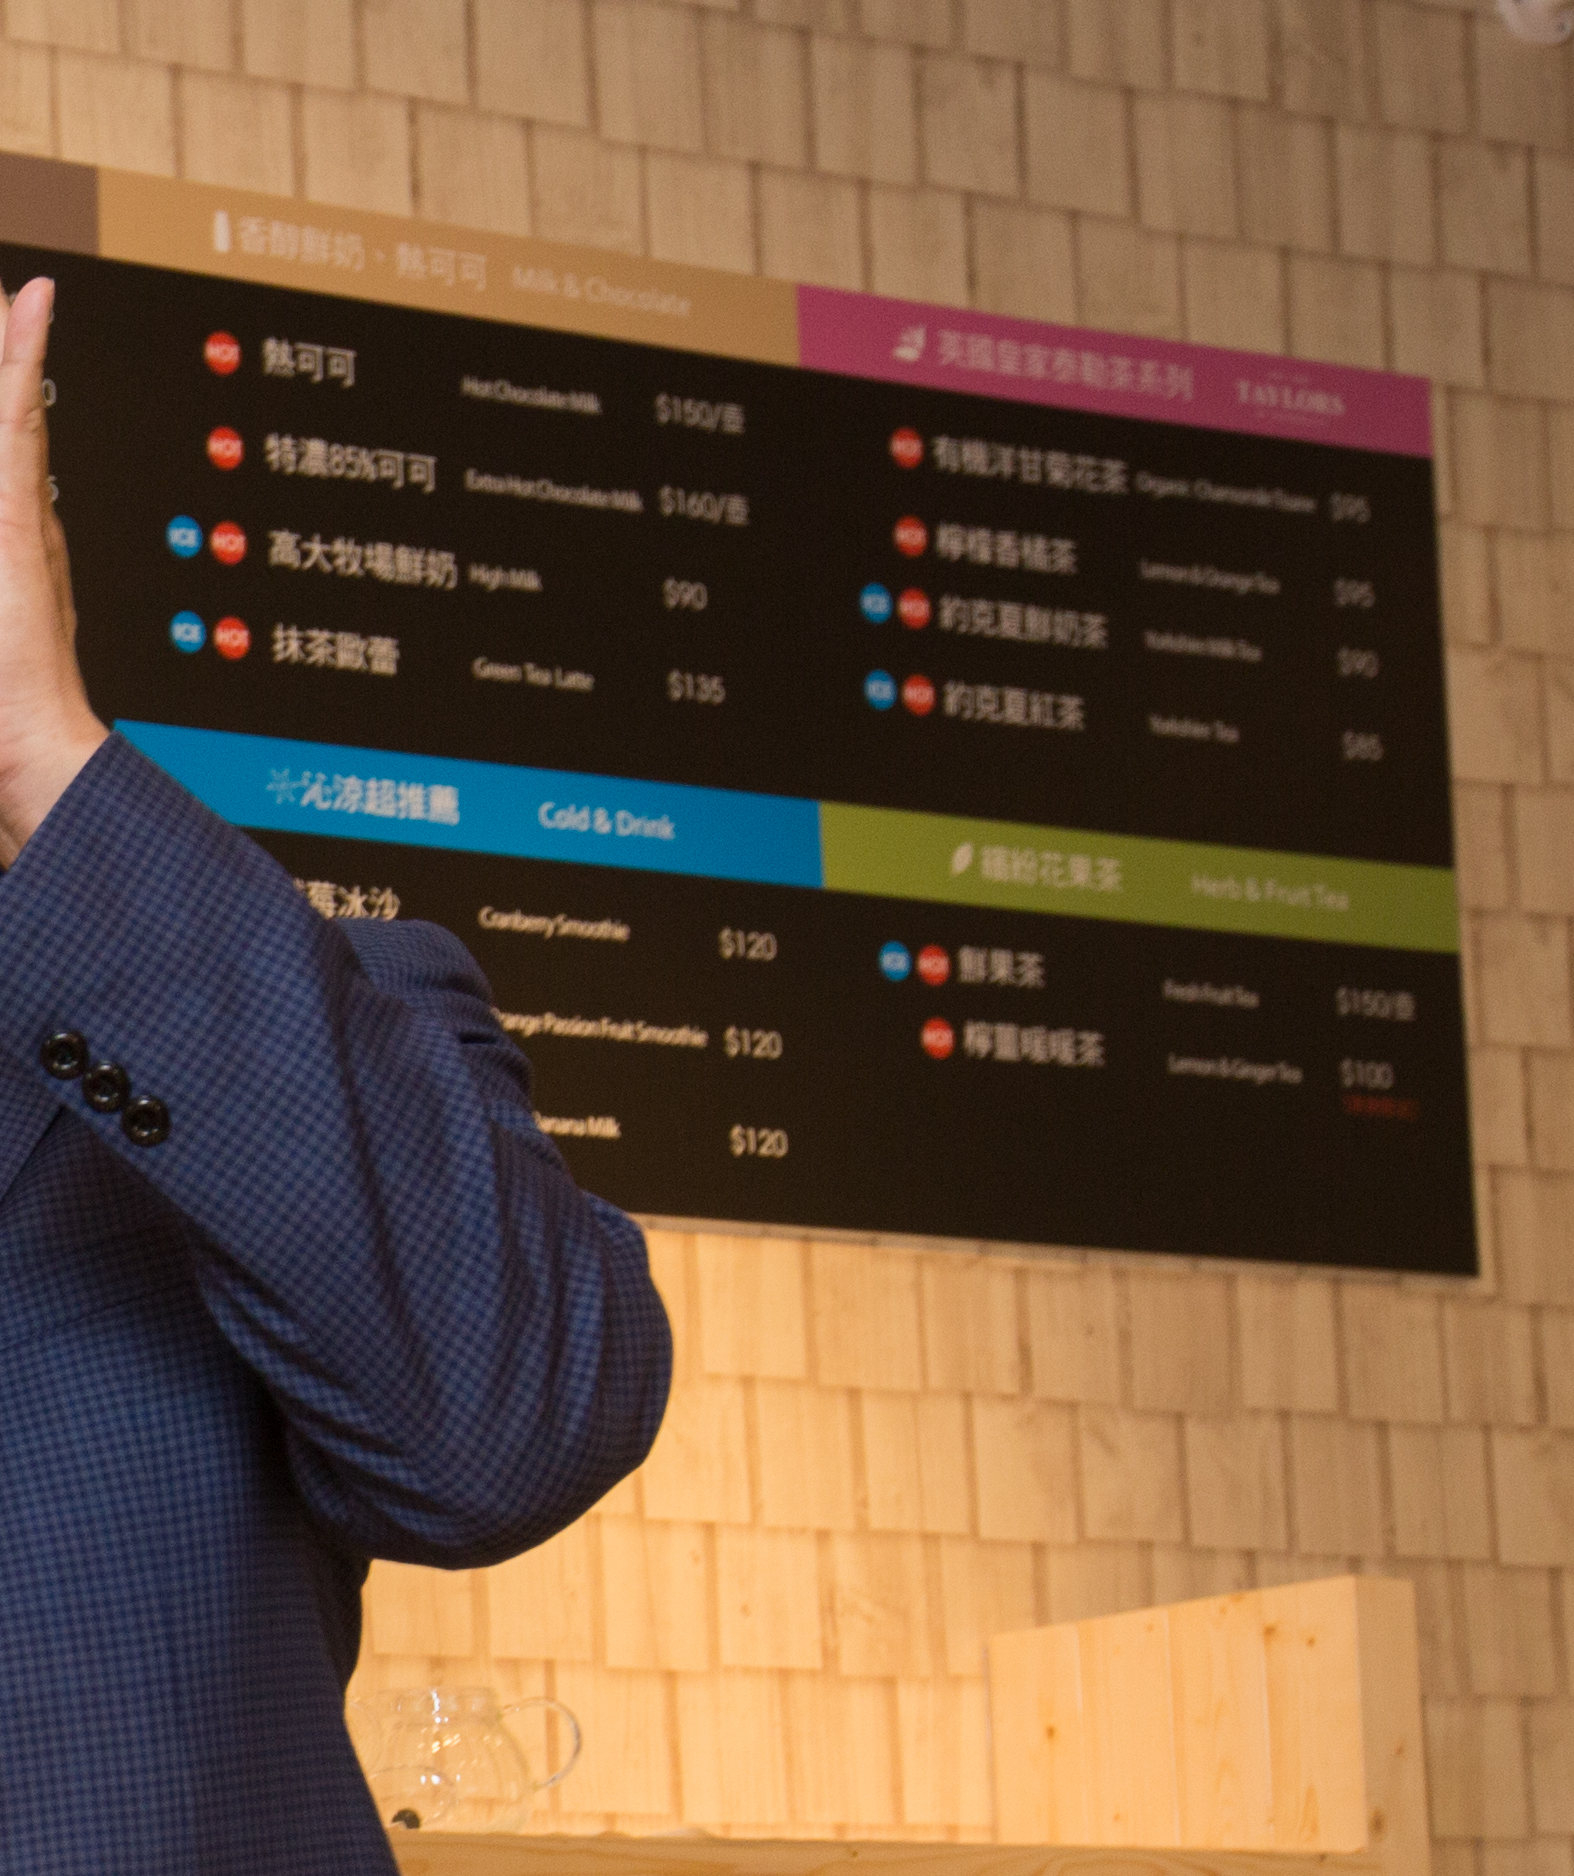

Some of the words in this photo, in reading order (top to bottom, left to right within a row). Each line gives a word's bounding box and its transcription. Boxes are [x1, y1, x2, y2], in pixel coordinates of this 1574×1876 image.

[205, 344, 241, 362] HOT
[262, 336, 357, 388] 熱可可
[208, 440, 244, 457] HOT
[265, 432, 437, 494] 特濃85%可可
[211, 533, 247, 552] HOT
[268, 528, 457, 590] 高大牧場鮮奶
[214, 627, 250, 646] HOT
[272, 622, 400, 677] 抹茶歐蕾
[539, 801, 591, 833] Cold
[592, 806, 613, 836] &
[616, 809, 676, 841] Drink
[1313, 883, 1350, 912] Tea
[719, 925, 778, 962] $120
[723, 1024, 784, 1060] $120
[729, 1123, 789, 1159] $120
